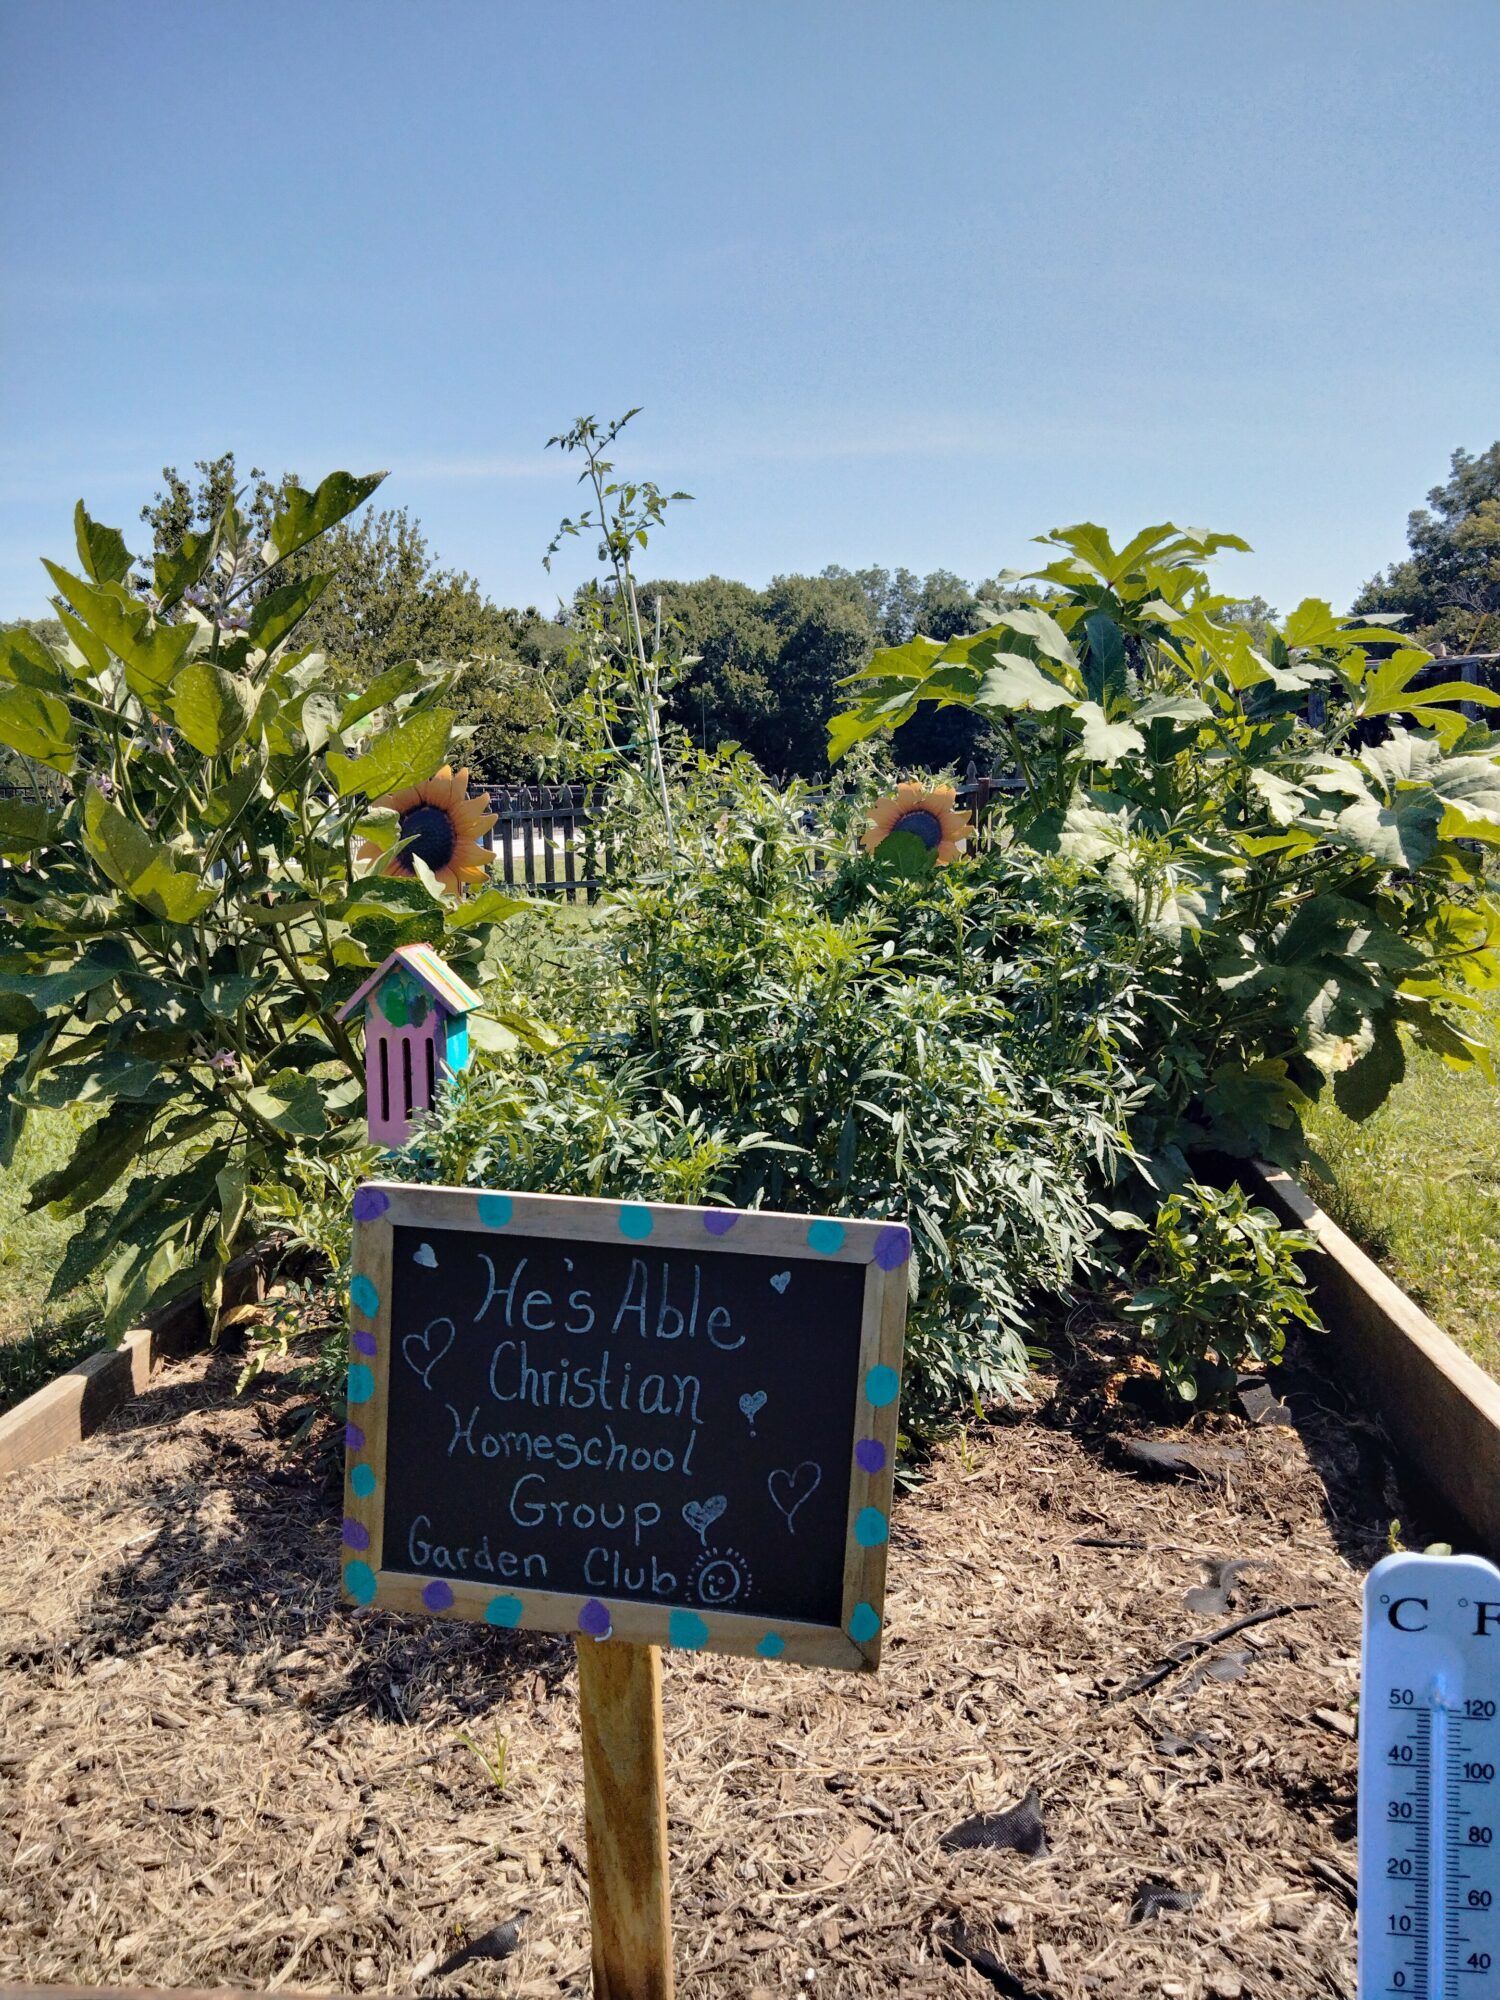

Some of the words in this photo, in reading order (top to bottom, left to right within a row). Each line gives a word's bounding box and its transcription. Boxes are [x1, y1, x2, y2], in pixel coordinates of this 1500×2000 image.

[473, 1252, 597, 1334] He's
[611, 1257, 746, 1351] Able
[488, 1340, 704, 1424] Christian
[444, 1403, 698, 1476] Homeschool
[510, 1473, 662, 1546] Group
[408, 1515, 547, 1578] Garden
[584, 1546, 677, 1595] Club
[1389, 1689, 1414, 1706] 50
[1464, 1700, 1496, 1717] 120
[1388, 1746, 1413, 1762] 40
[1463, 1763, 1495, 1779] 100
[1387, 1802, 1412, 1819] 30
[1468, 1827, 1493, 1843] 80
[1387, 1859, 1412, 1875] 20
[1468, 1890, 1492, 1907] 60
[1387, 1915, 1411, 1932] 10
[1467, 1953, 1491, 1969] 40
[1393, 1971, 1406, 1988] 0
